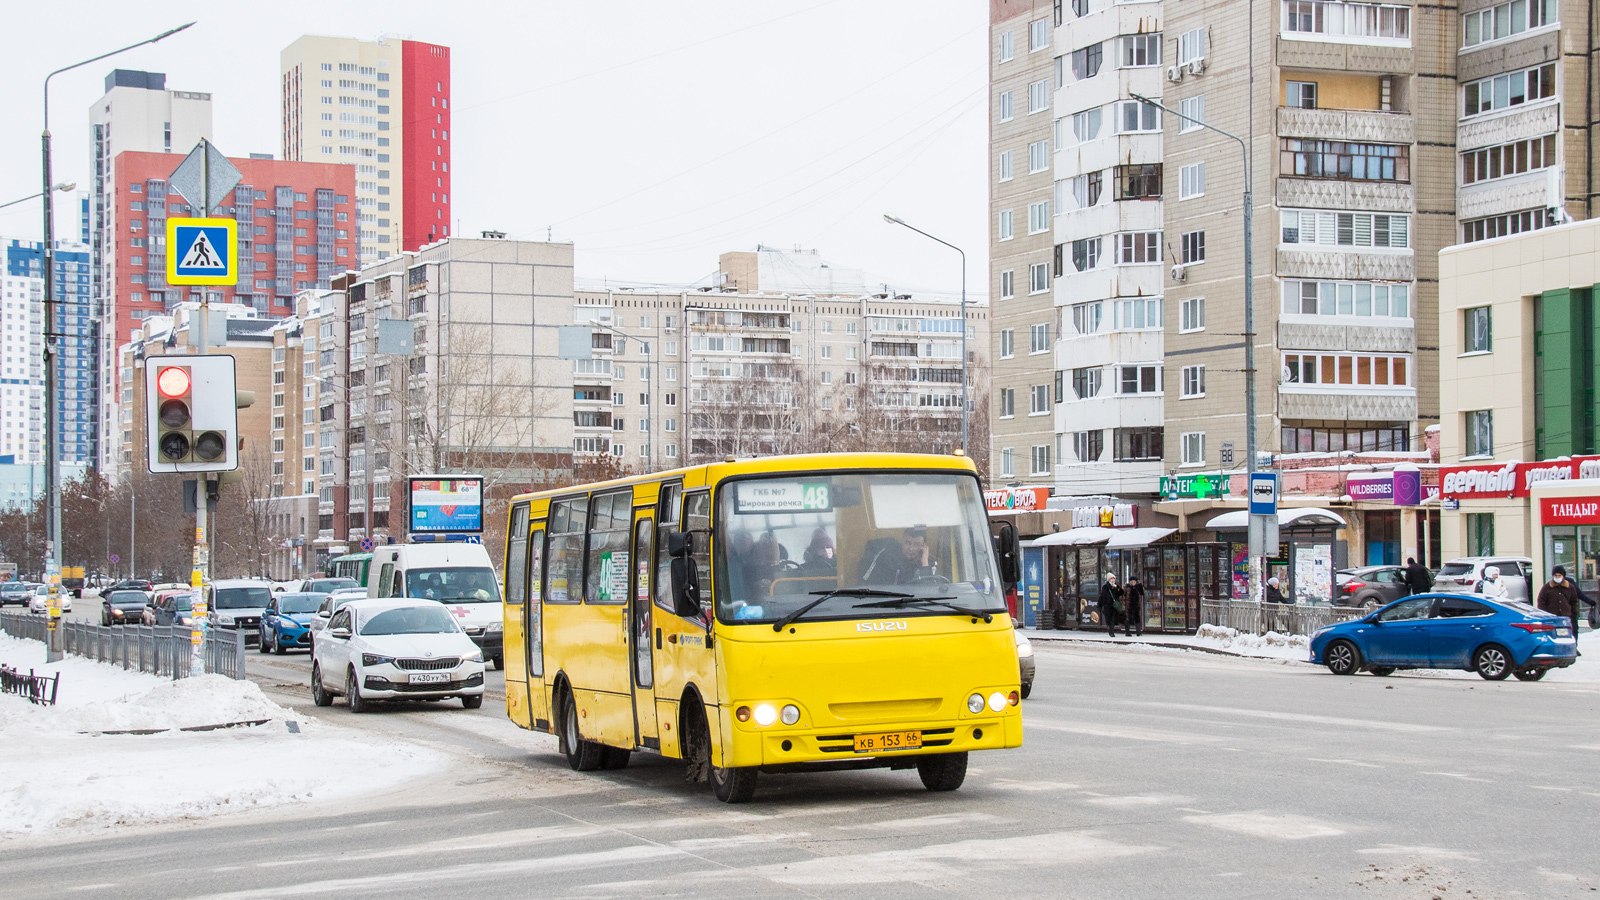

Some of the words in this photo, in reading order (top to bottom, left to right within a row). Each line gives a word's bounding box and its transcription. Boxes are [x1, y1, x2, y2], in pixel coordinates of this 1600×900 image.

[753, 488, 769, 496] ГКБ
[771, 488, 786, 496] №7
[1350, 484, 1392, 495] WILDBERRIES
[804, 486, 828, 509] 48
[739, 500, 776, 509] Широкая
[778, 500, 802, 508] речка
[1552, 503, 1598, 518] ТАНДЫР
[600, 557, 611, 594] 48
[856, 621, 907, 632] ISUZU
[860, 738, 874, 748] КВ
[879, 734, 900, 747] 153
[906, 732, 918, 742] 66
